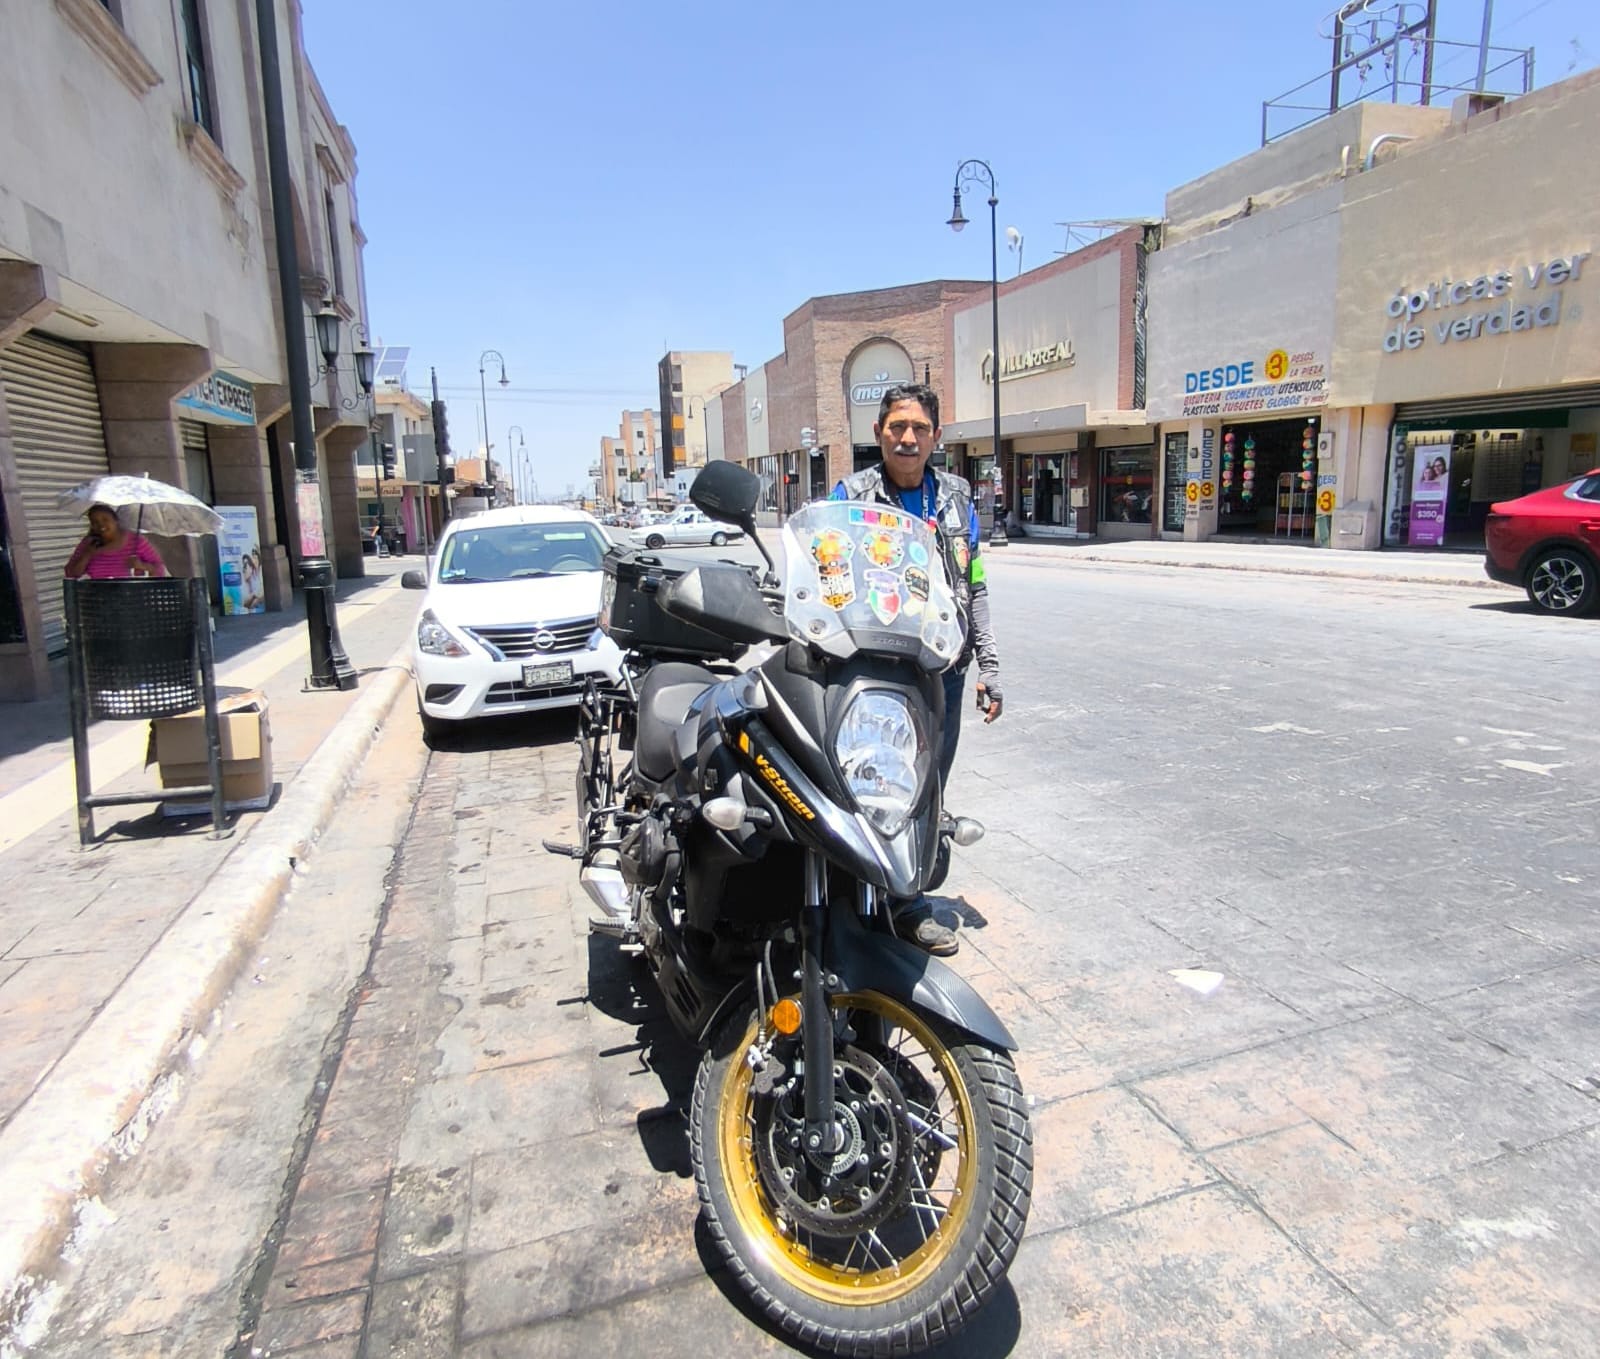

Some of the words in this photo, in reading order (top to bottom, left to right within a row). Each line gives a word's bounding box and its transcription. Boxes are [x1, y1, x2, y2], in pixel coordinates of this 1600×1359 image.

[1386, 270, 1512, 322] ópticas
[1522, 252, 1592, 290] ver
[1383, 320, 1426, 354] de
[1434, 289, 1562, 345] verdad
[1185, 361, 1254, 393] DESDE
[1268, 352, 1285, 380] 3
[1278, 379, 1326, 395] UTENSILIOS
[217, 379, 252, 415] EXPRESS
[1182, 403, 1220, 417] PLASTICOS
[1222, 399, 1265, 413] JUGUETES
[1266, 395, 1303, 409] GLOBOS
[1201, 428, 1215, 480] DESDE
[1188, 482, 1198, 502] 3
[1200, 481, 1213, 498] 3
[1319, 490, 1333, 513] 3
